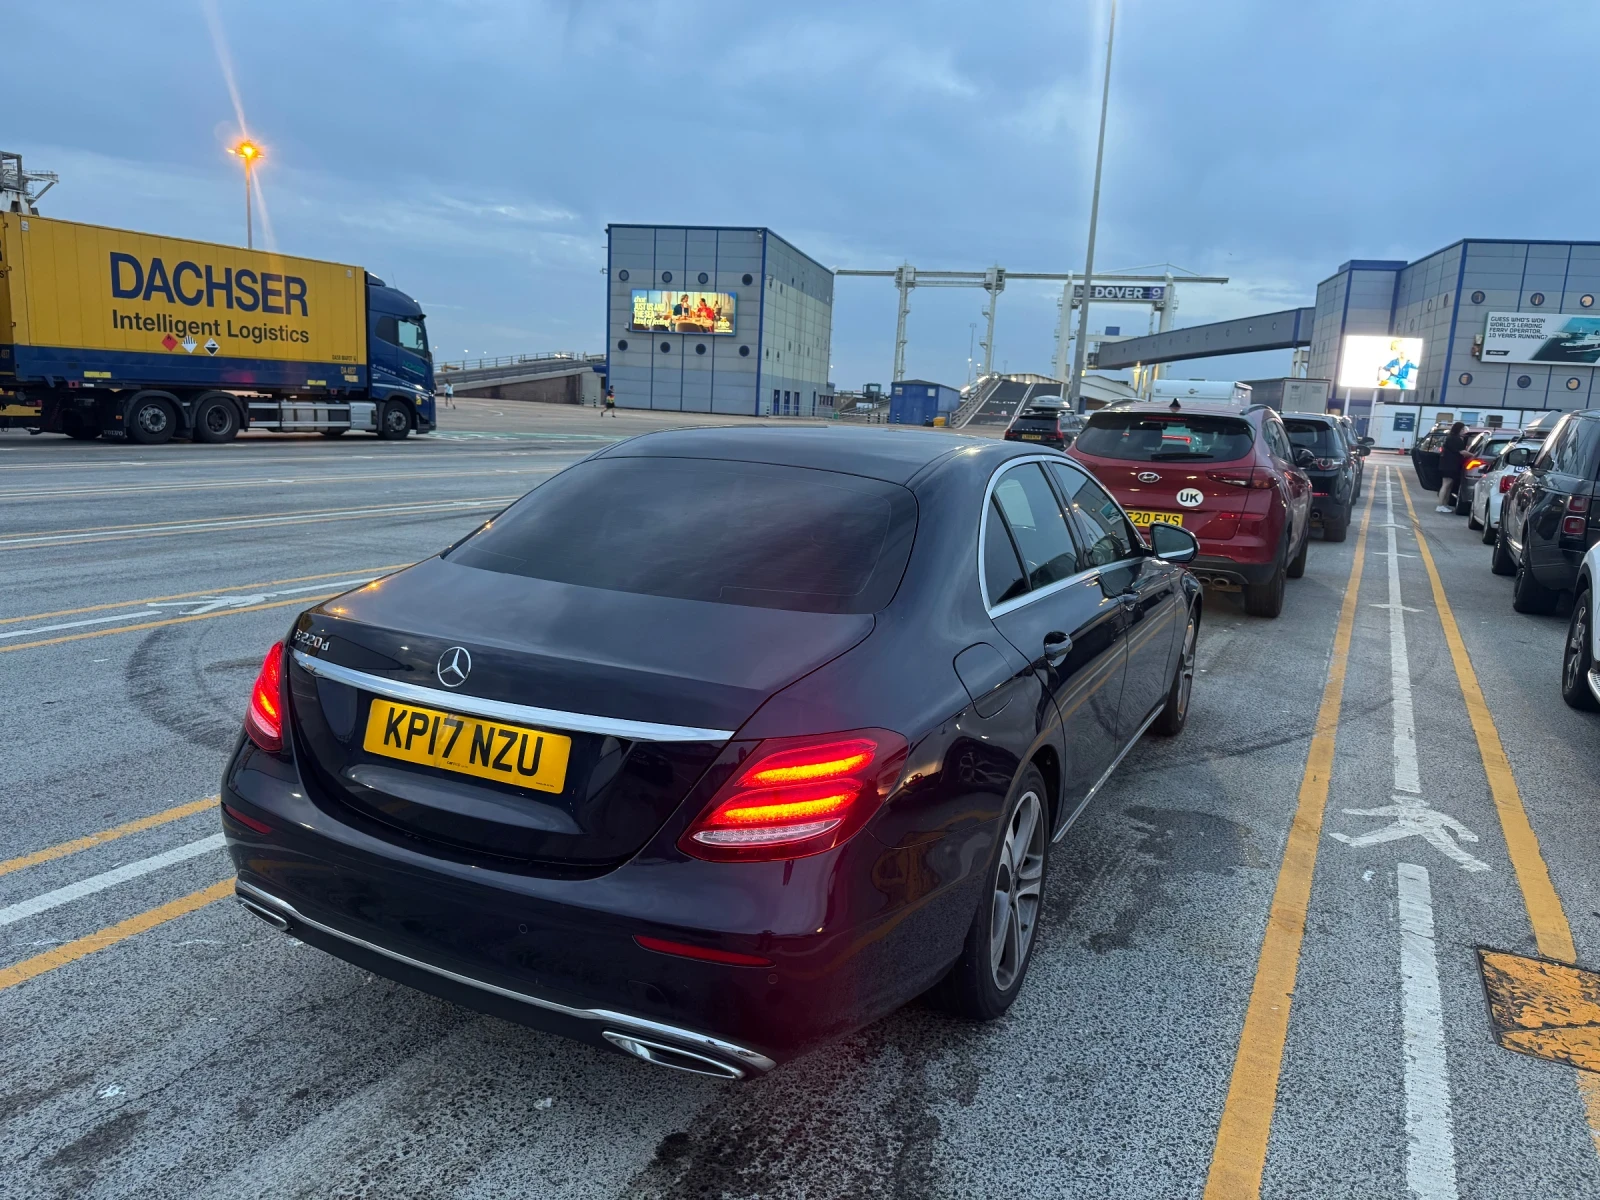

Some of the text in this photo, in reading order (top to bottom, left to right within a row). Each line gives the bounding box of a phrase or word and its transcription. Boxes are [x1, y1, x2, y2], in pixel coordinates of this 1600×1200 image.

[110, 251, 309, 317] DACHSER
[1095, 287, 1161, 299] DOVER 9
[112, 309, 310, 343] Intelligent Logistics
[1180, 492, 1199, 503] UK
[295, 628, 330, 651] E220d
[383, 707, 544, 777] KP17 NZU
